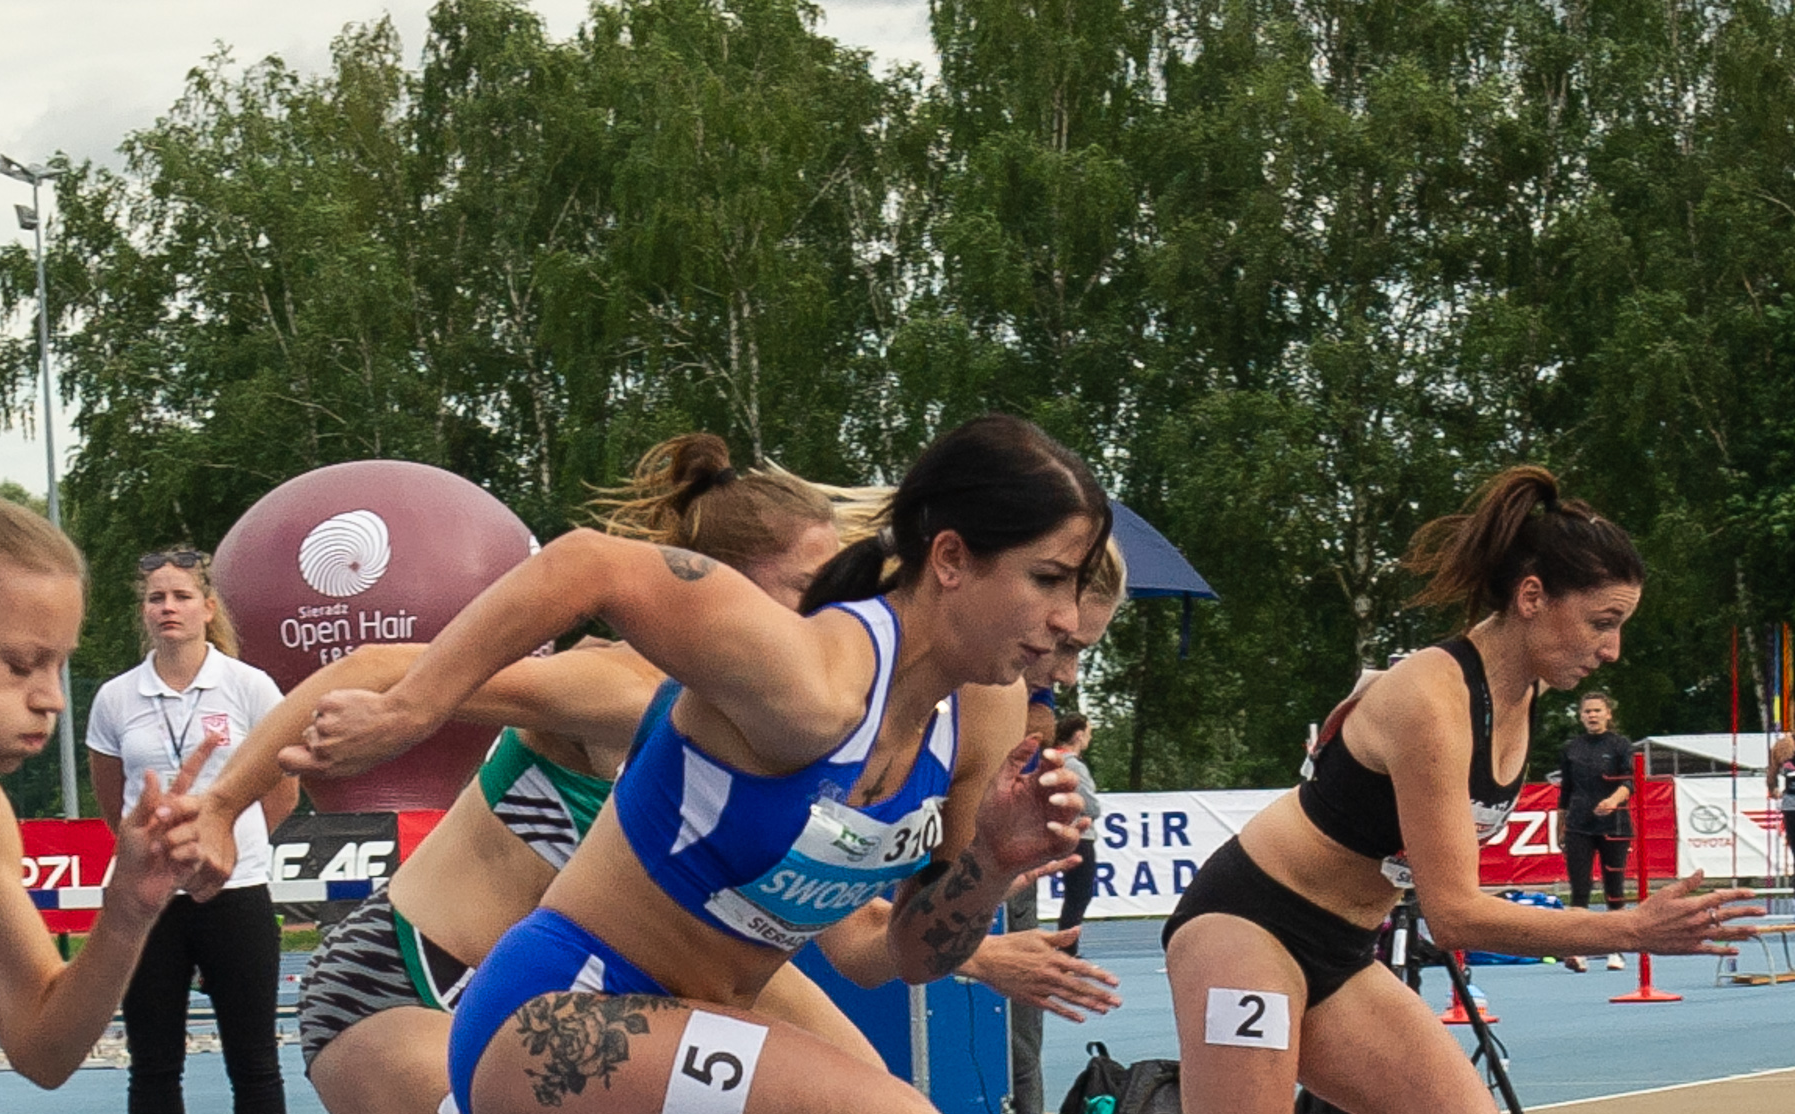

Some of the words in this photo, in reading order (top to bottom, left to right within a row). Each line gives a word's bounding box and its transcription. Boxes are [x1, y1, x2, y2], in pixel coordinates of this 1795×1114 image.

[280, 618, 351, 652] Open
[359, 609, 417, 640] Hair
[297, 603, 349, 619] Sieradz
[884, 815, 937, 862] 310
[1235, 995, 1265, 1038] 2
[682, 1044, 744, 1092] 5
